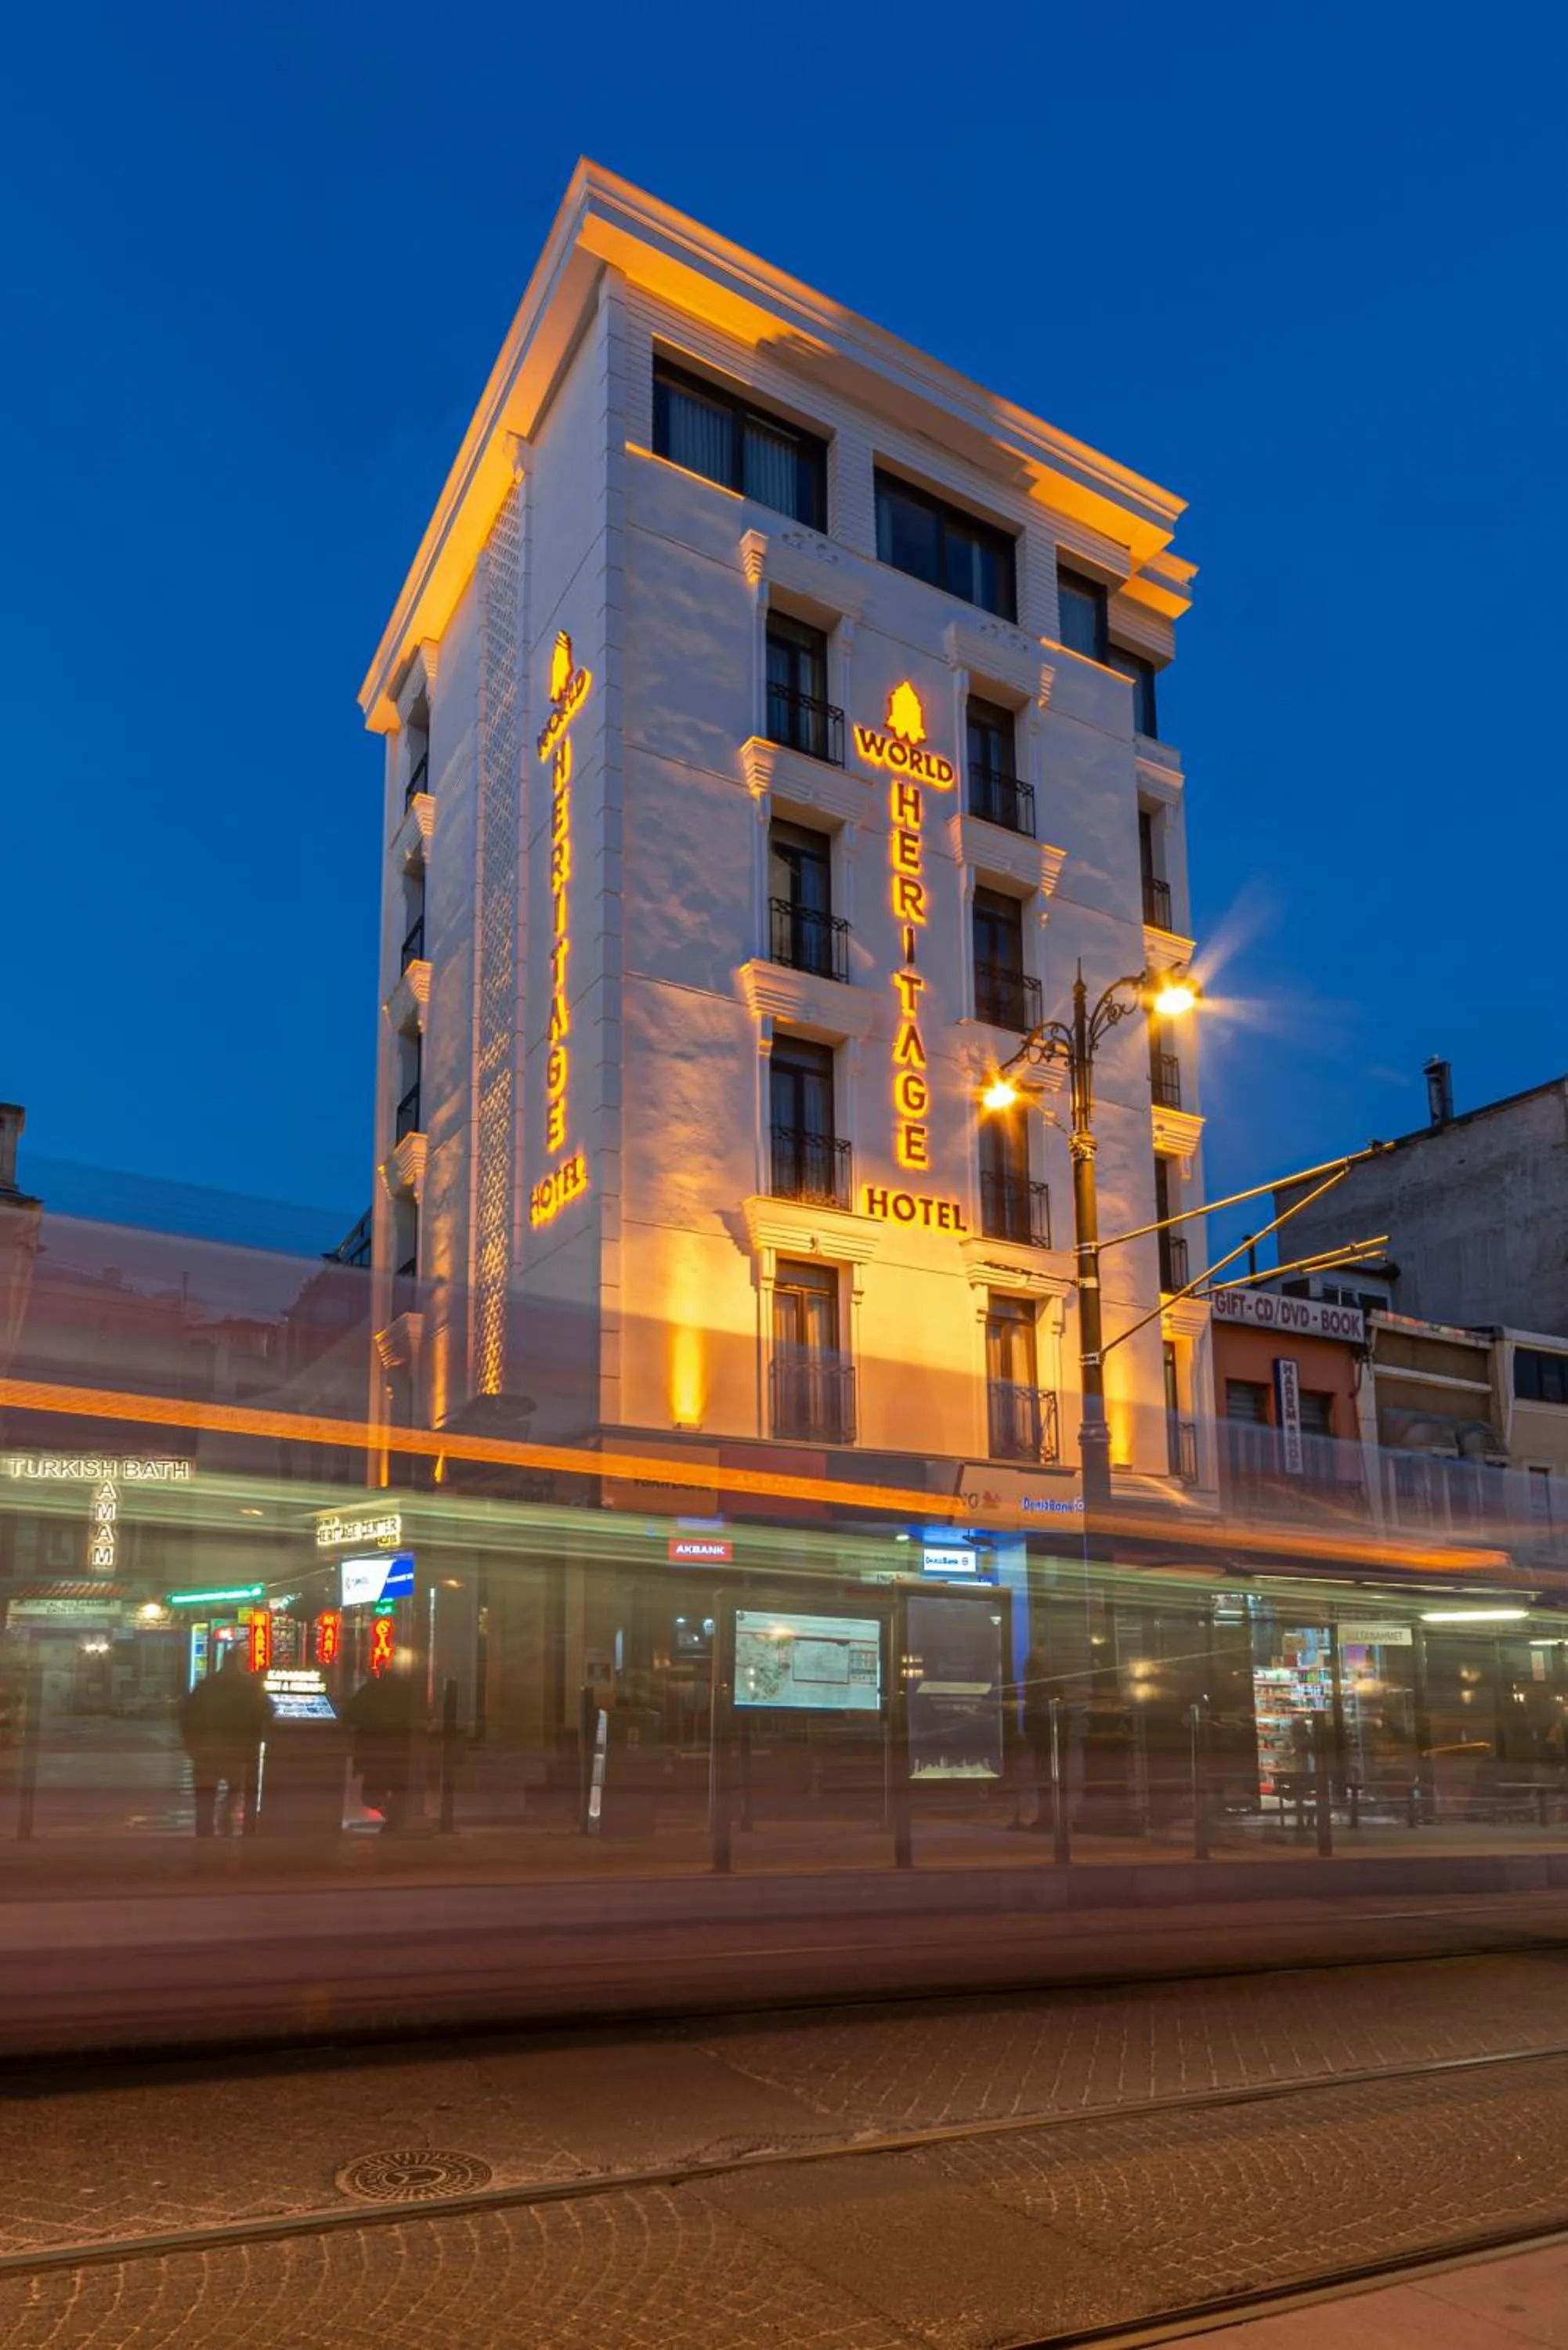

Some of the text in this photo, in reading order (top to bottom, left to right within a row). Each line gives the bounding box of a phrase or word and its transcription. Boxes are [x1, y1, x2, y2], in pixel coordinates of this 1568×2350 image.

[855, 725, 954, 788] WORLD
[891, 781, 927, 1169] HERITAGE
[866, 1187, 967, 1233] HOTEL
[1215, 1291, 1245, 1318] GIFT
[1255, 1296, 1310, 1328] CD/DVD
[1321, 1309, 1360, 1337] BOOK
[9, 1459, 190, 1480] TURKISH BATH
[676, 1544, 726, 1555] AKBANK
